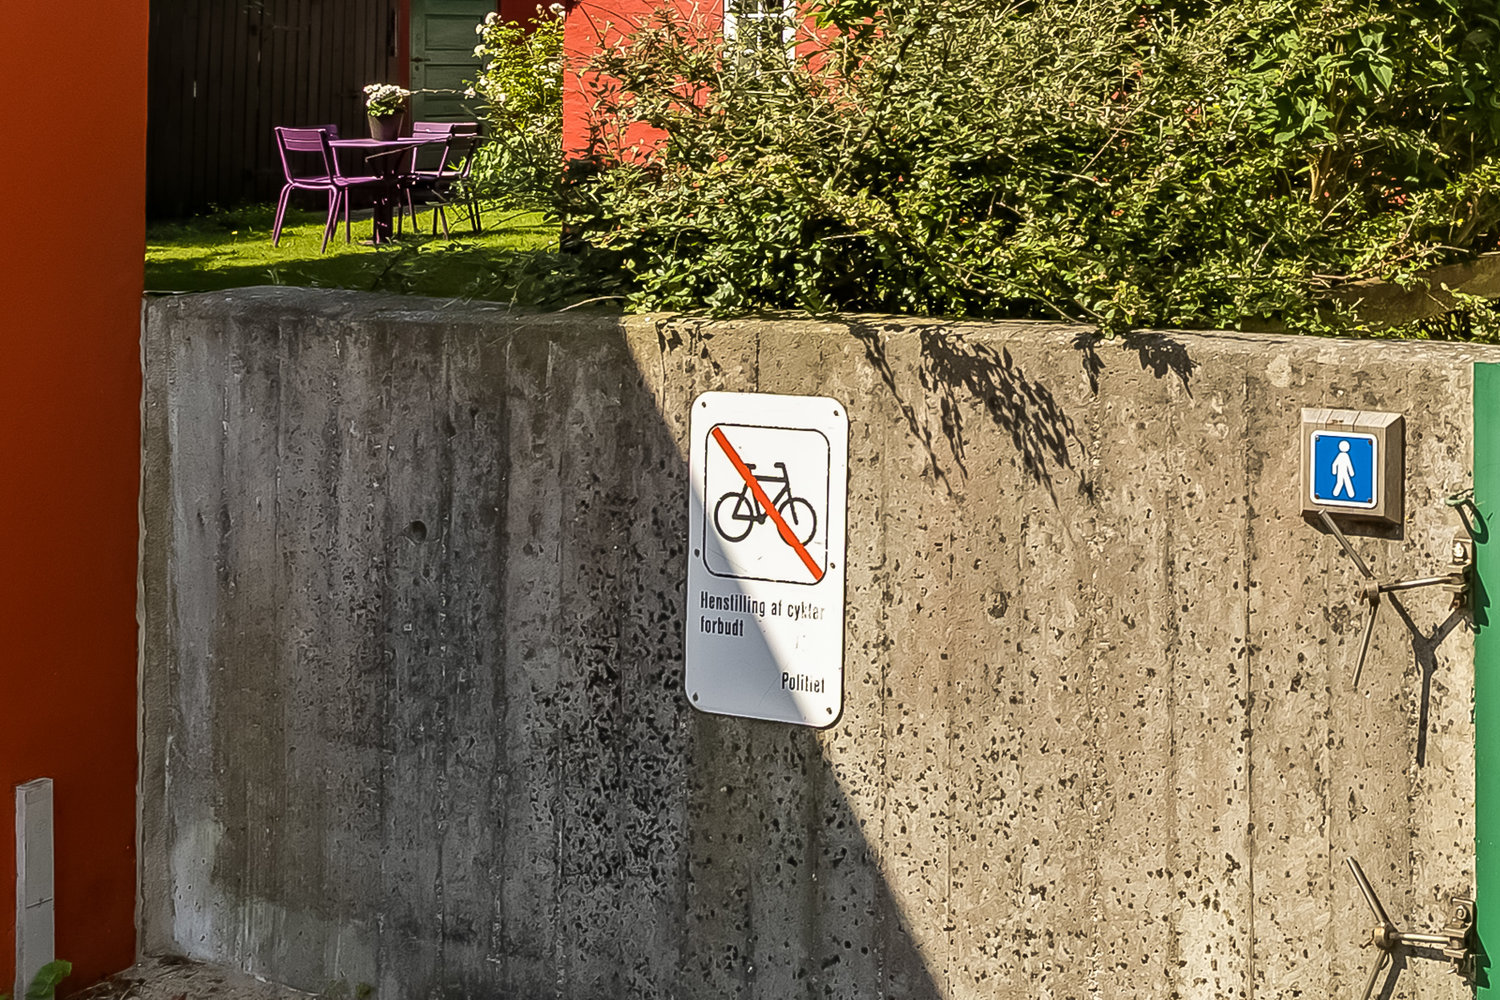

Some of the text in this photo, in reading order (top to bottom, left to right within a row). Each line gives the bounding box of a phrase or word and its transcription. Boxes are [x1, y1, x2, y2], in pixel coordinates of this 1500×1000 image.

[700, 591, 765, 617] Henstilling
[771, 600, 782, 616] af
[700, 615, 743, 636] forbudt
[781, 672, 824, 693] Politiet
